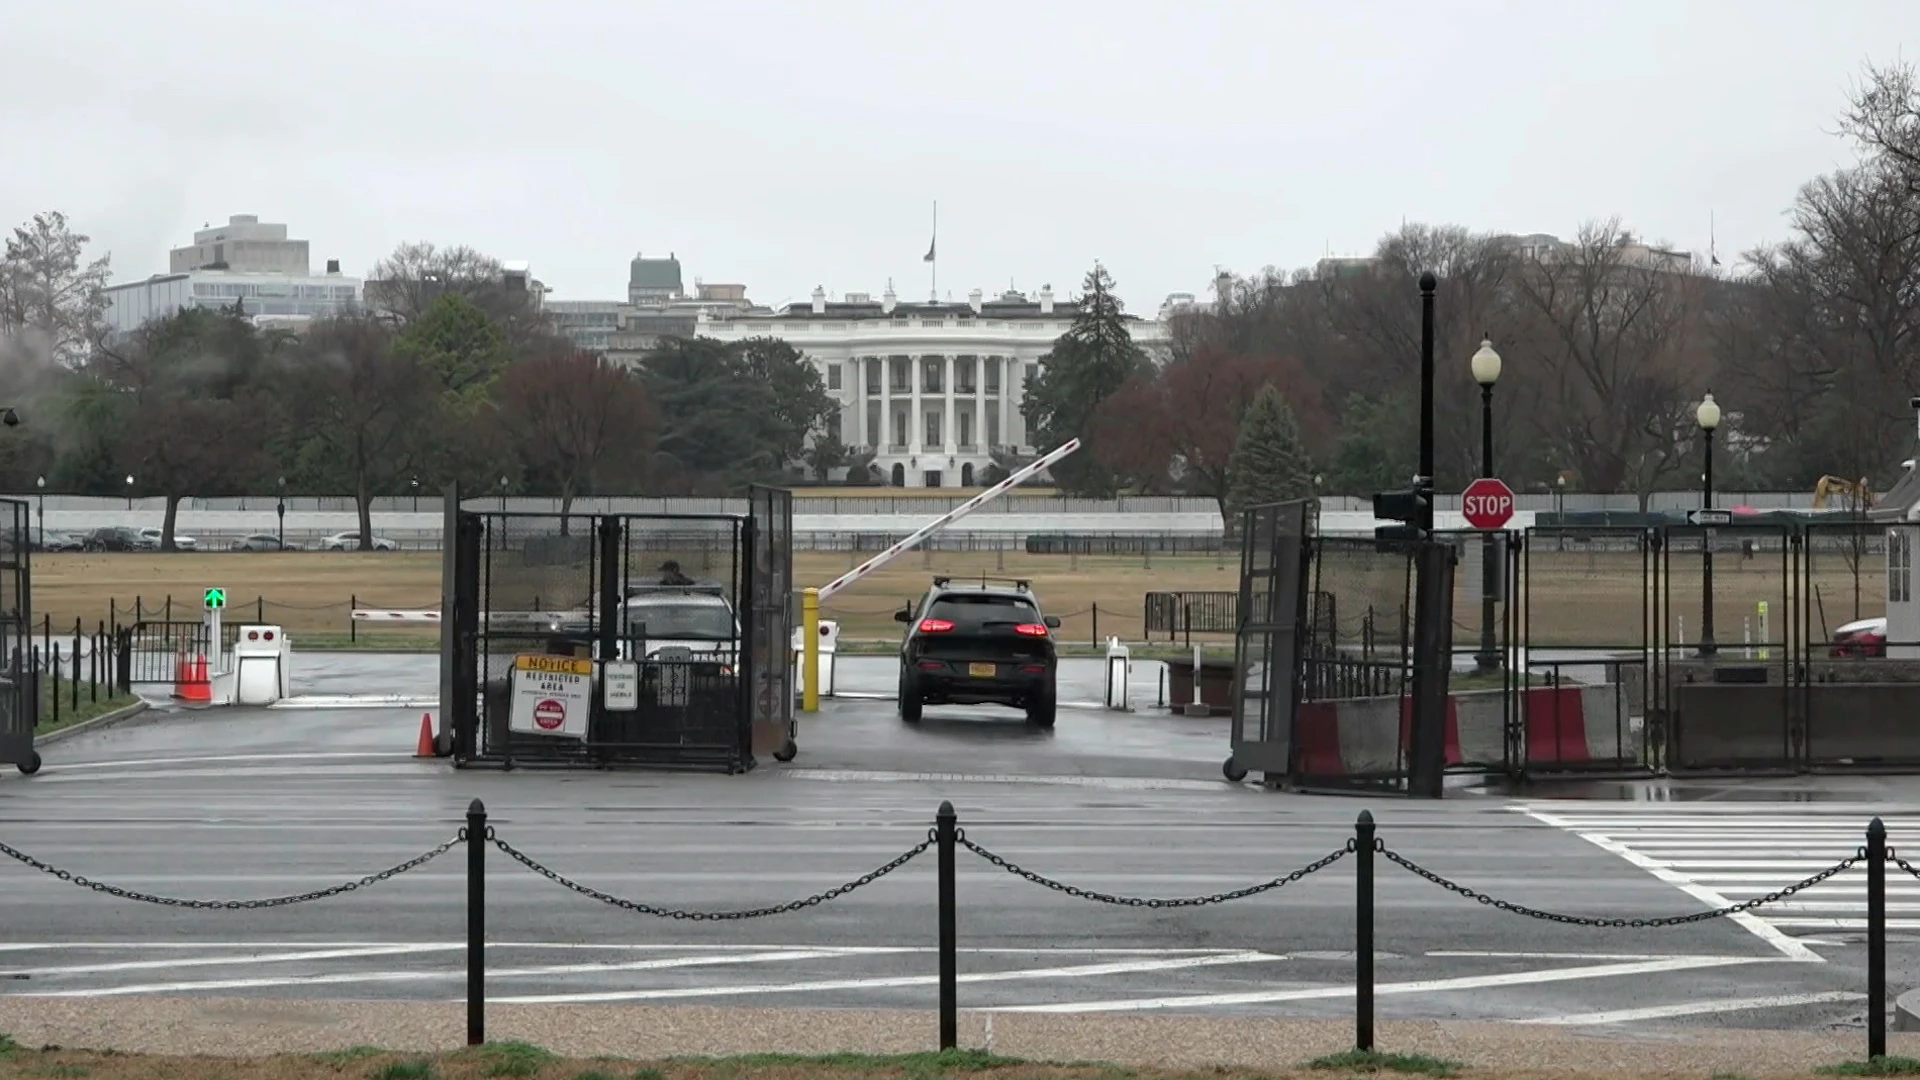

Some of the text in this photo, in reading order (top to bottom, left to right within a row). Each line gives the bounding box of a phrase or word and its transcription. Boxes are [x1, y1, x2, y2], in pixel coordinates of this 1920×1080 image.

[1465, 495, 1511, 516] STOP
[528, 657, 579, 671] NOTICE
[526, 672, 580, 684] RESTRICTED
[540, 682, 564, 691] AREA
